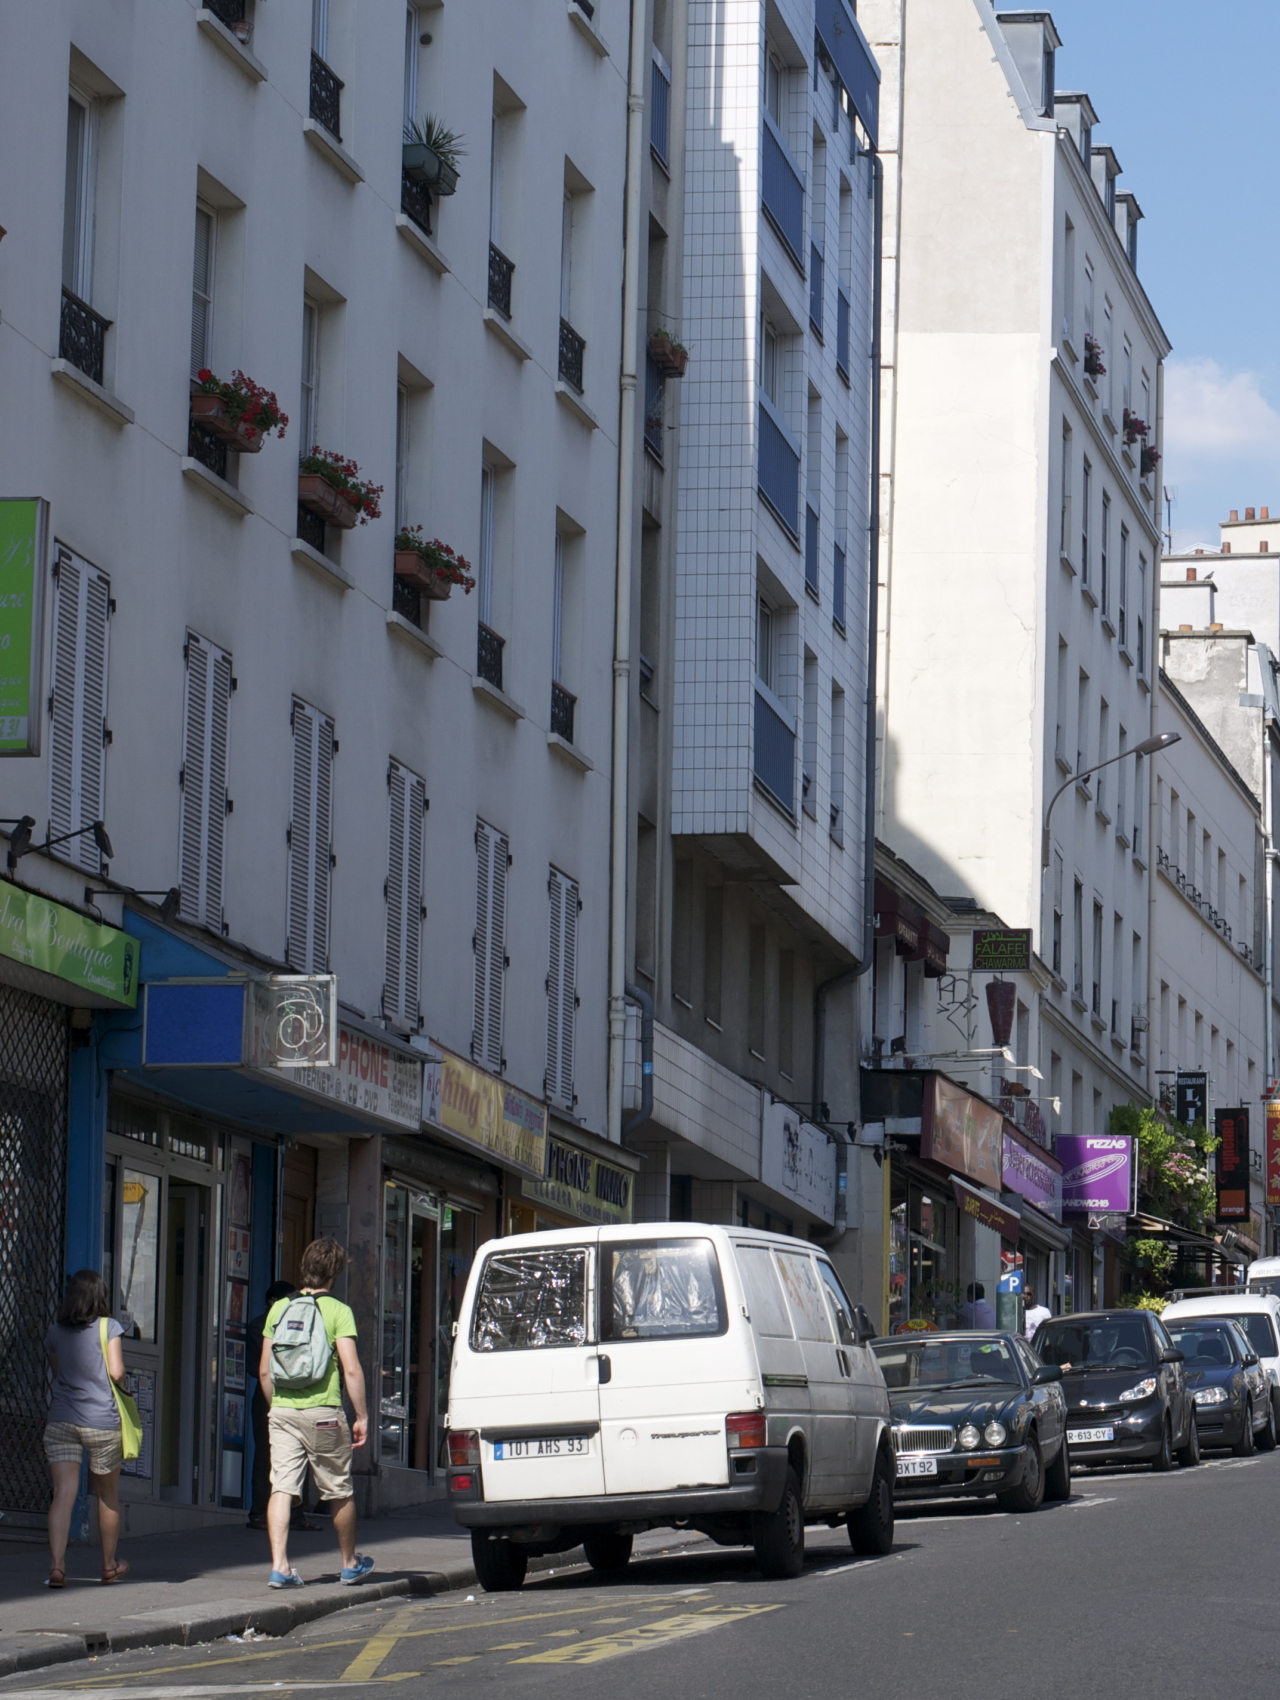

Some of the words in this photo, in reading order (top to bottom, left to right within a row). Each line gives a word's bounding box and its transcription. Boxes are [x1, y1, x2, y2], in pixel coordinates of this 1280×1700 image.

[32, 901, 114, 976] Boutique
[975, 943, 1029, 955] FALAFEL
[974, 957, 1027, 969] CHAWARMA
[337, 1029, 390, 1090] PHONE
[1177, 1077, 1206, 1086] RESTAURANT
[1086, 1138, 1127, 1149] PIZZAS
[1221, 1206, 1245, 1214] orange
[1009, 1276, 1020, 1292] P
[650, 1429, 722, 1440] Transporter
[508, 1441, 530, 1457] 101
[537, 1439, 561, 1455] AHS
[567, 1436, 583, 1453] 93
[919, 1460, 933, 1474] 92
